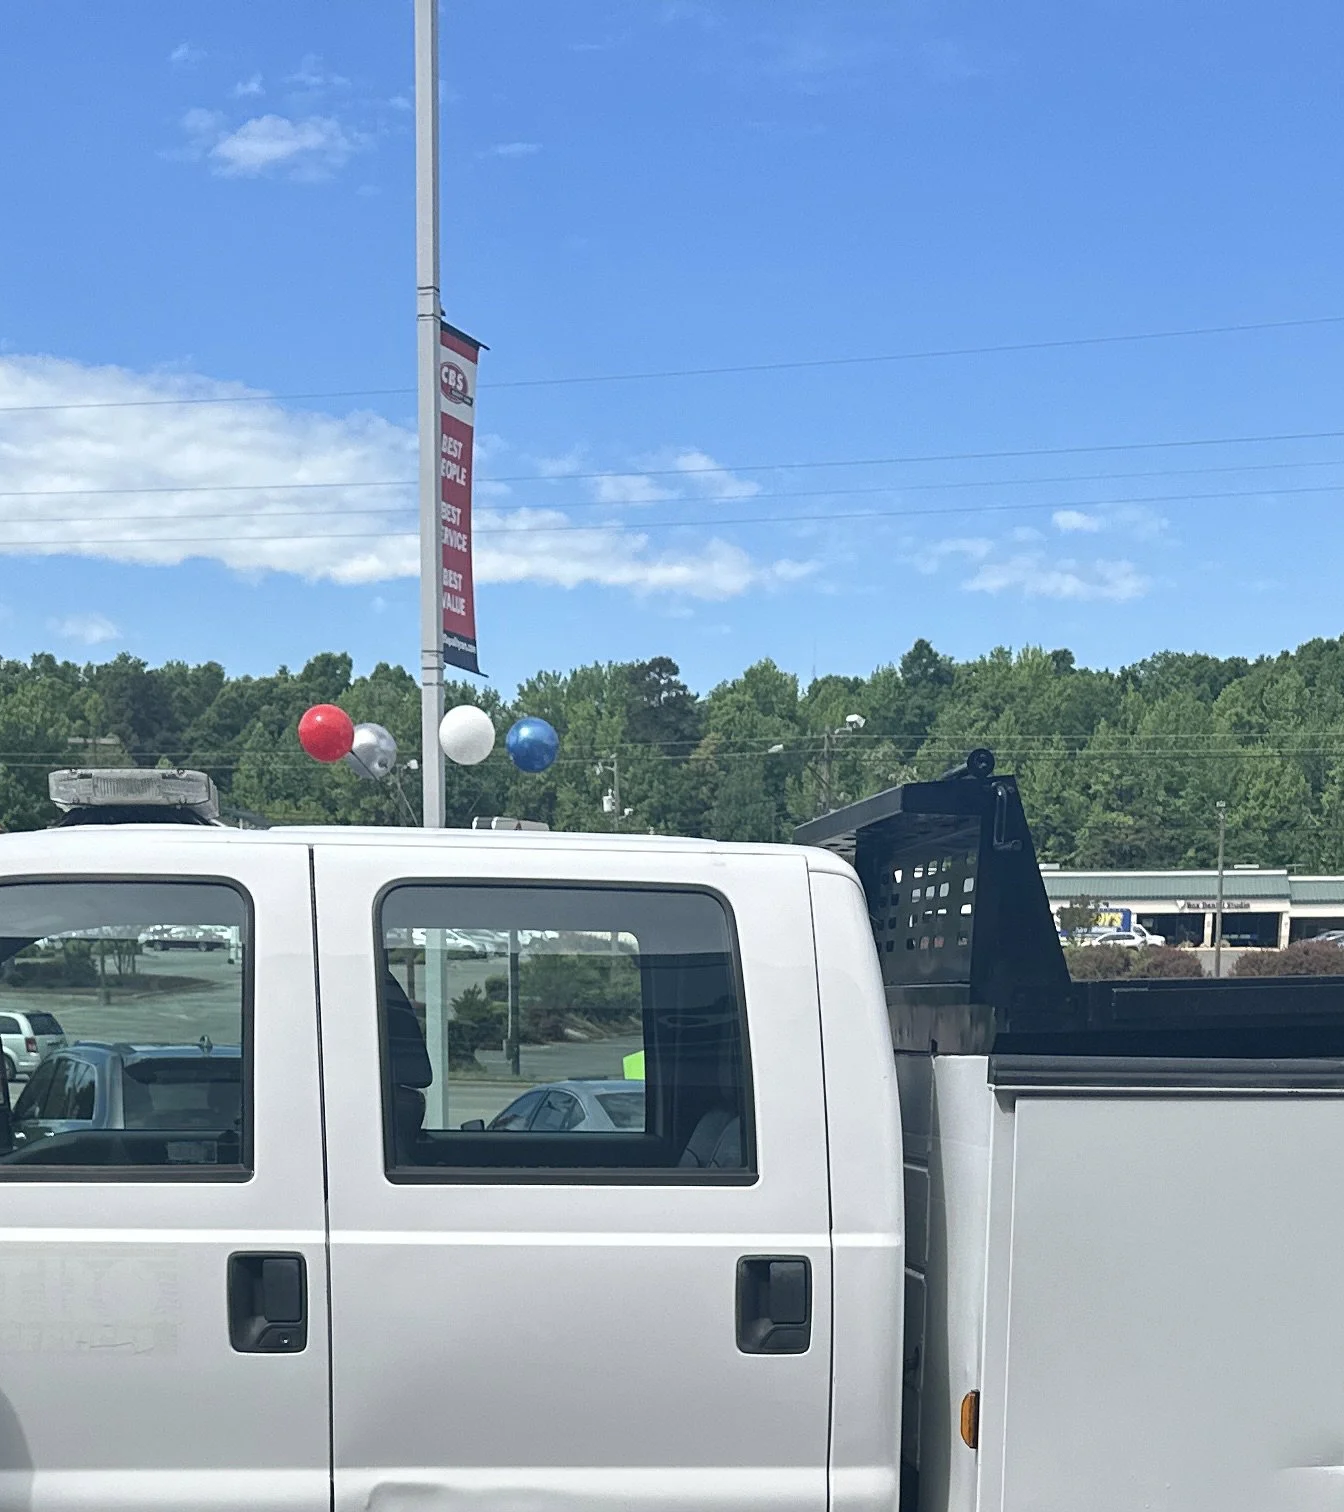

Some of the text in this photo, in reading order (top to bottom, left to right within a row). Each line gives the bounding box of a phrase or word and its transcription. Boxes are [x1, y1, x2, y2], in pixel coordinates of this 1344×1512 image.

[441, 366, 464, 391] CBS
[441, 433, 463, 460] BEST
[440, 457, 467, 486] EOPLE
[440, 501, 462, 527] BEST
[442, 567, 463, 592] BEST
[442, 592, 467, 616] VALUE
